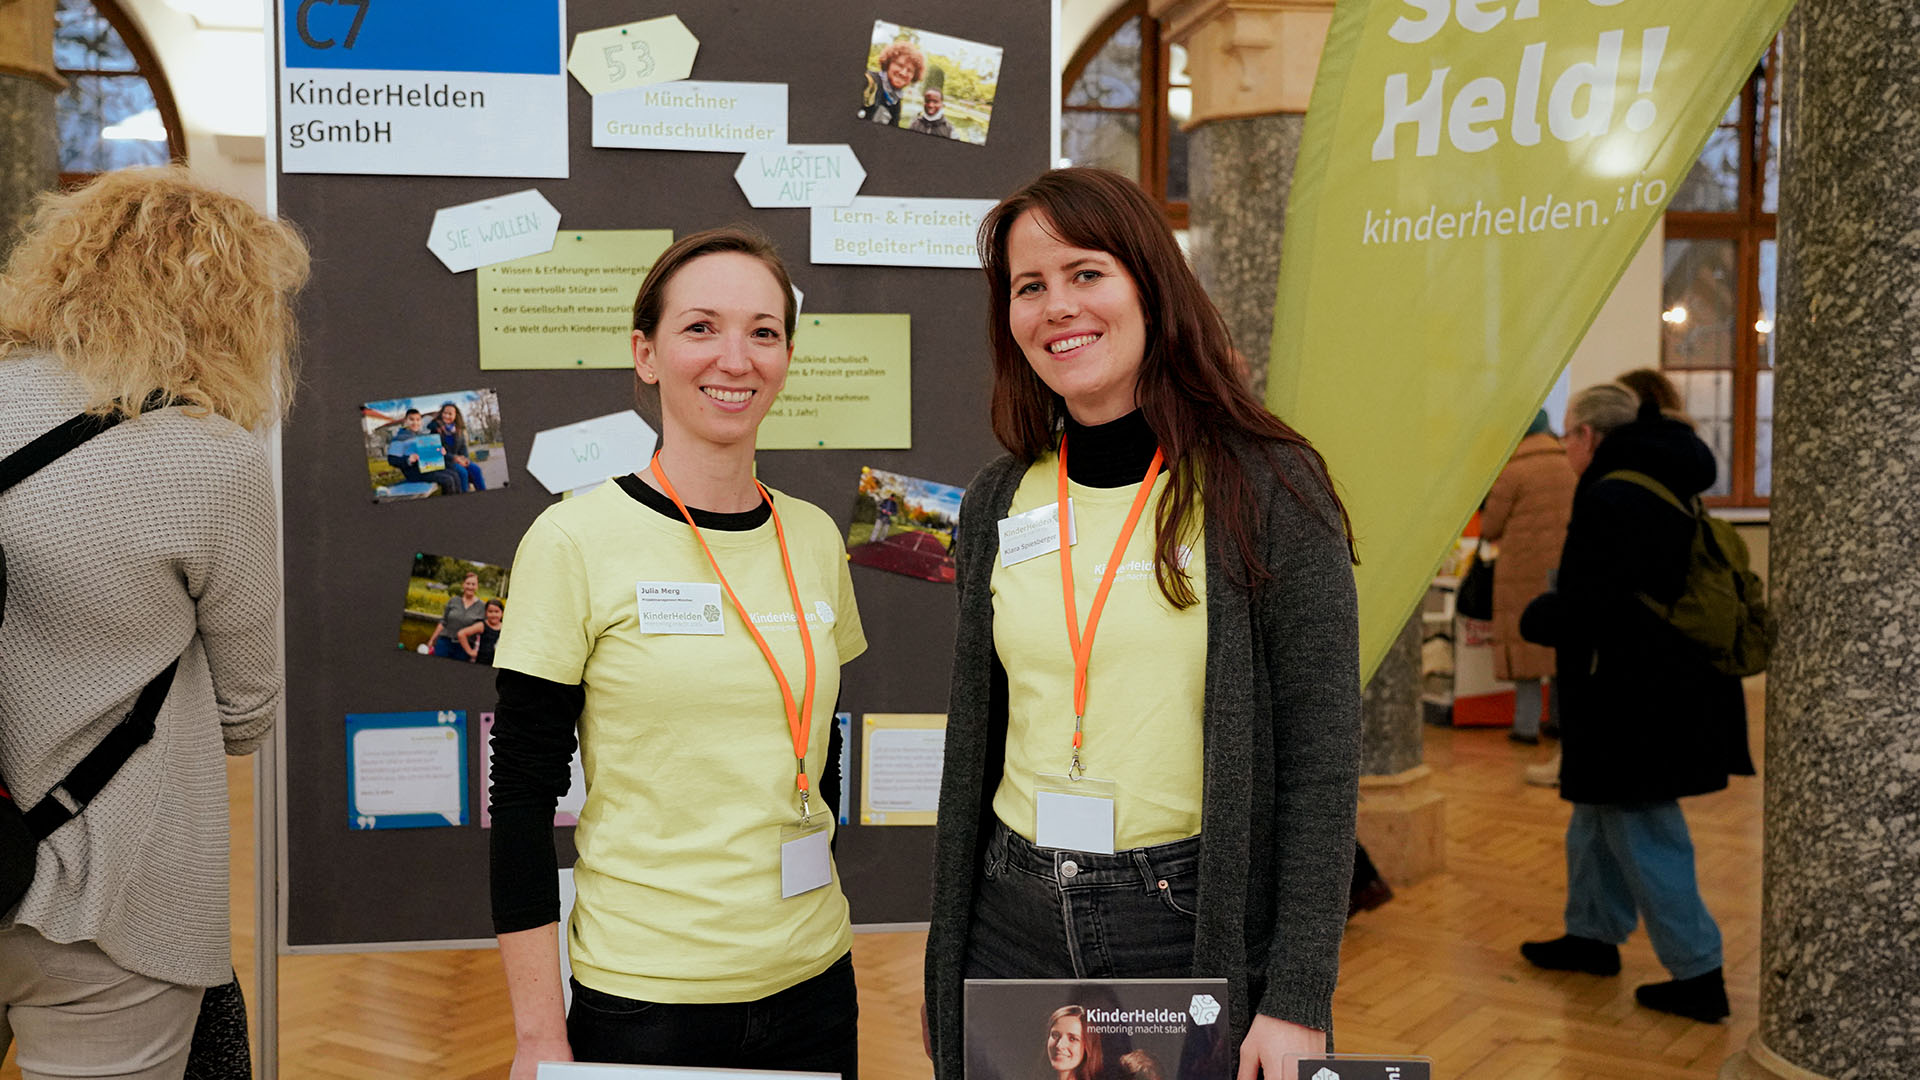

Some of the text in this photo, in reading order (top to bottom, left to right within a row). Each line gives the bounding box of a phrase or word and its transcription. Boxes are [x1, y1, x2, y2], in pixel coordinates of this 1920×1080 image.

[296, 0, 370, 50] C7
[603, 40, 655, 83] 53
[290, 80, 485, 108] KinderHelden
[645, 91, 737, 110] Münchner
[1371, 26, 1670, 161] Held!
[290, 120, 391, 148] gGmbH
[607, 120, 776, 140] Grundschulkinder
[761, 156, 841, 179] WARTEN
[779, 181, 816, 201] AUF
[833, 208, 977, 226] Lern- & Freizeit-
[446, 228, 472, 251] SIE
[501, 266, 533, 274] Wissen
[535, 266, 542, 274] &
[543, 265, 600, 276] Erfahrungen
[501, 286, 521, 294] eine
[523, 285, 566, 294] wertvolle
[600, 286, 618, 294] sein
[502, 305, 517, 314] der
[520, 305, 575, 314] Gesellschaft
[577, 305, 604, 313] etwas
[503, 325, 517, 334] die
[519, 325, 540, 334] Welt
[542, 325, 569, 334] durch
[571, 325, 628, 335] Kinderaugen
[571, 442, 601, 463] WO
[641, 587, 681, 596] Julia Merg
[643, 611, 703, 621] KinderHelden
[1086, 1008, 1187, 1022] KinderHelden
[1087, 1024, 1187, 1036] mentoring macht stark
